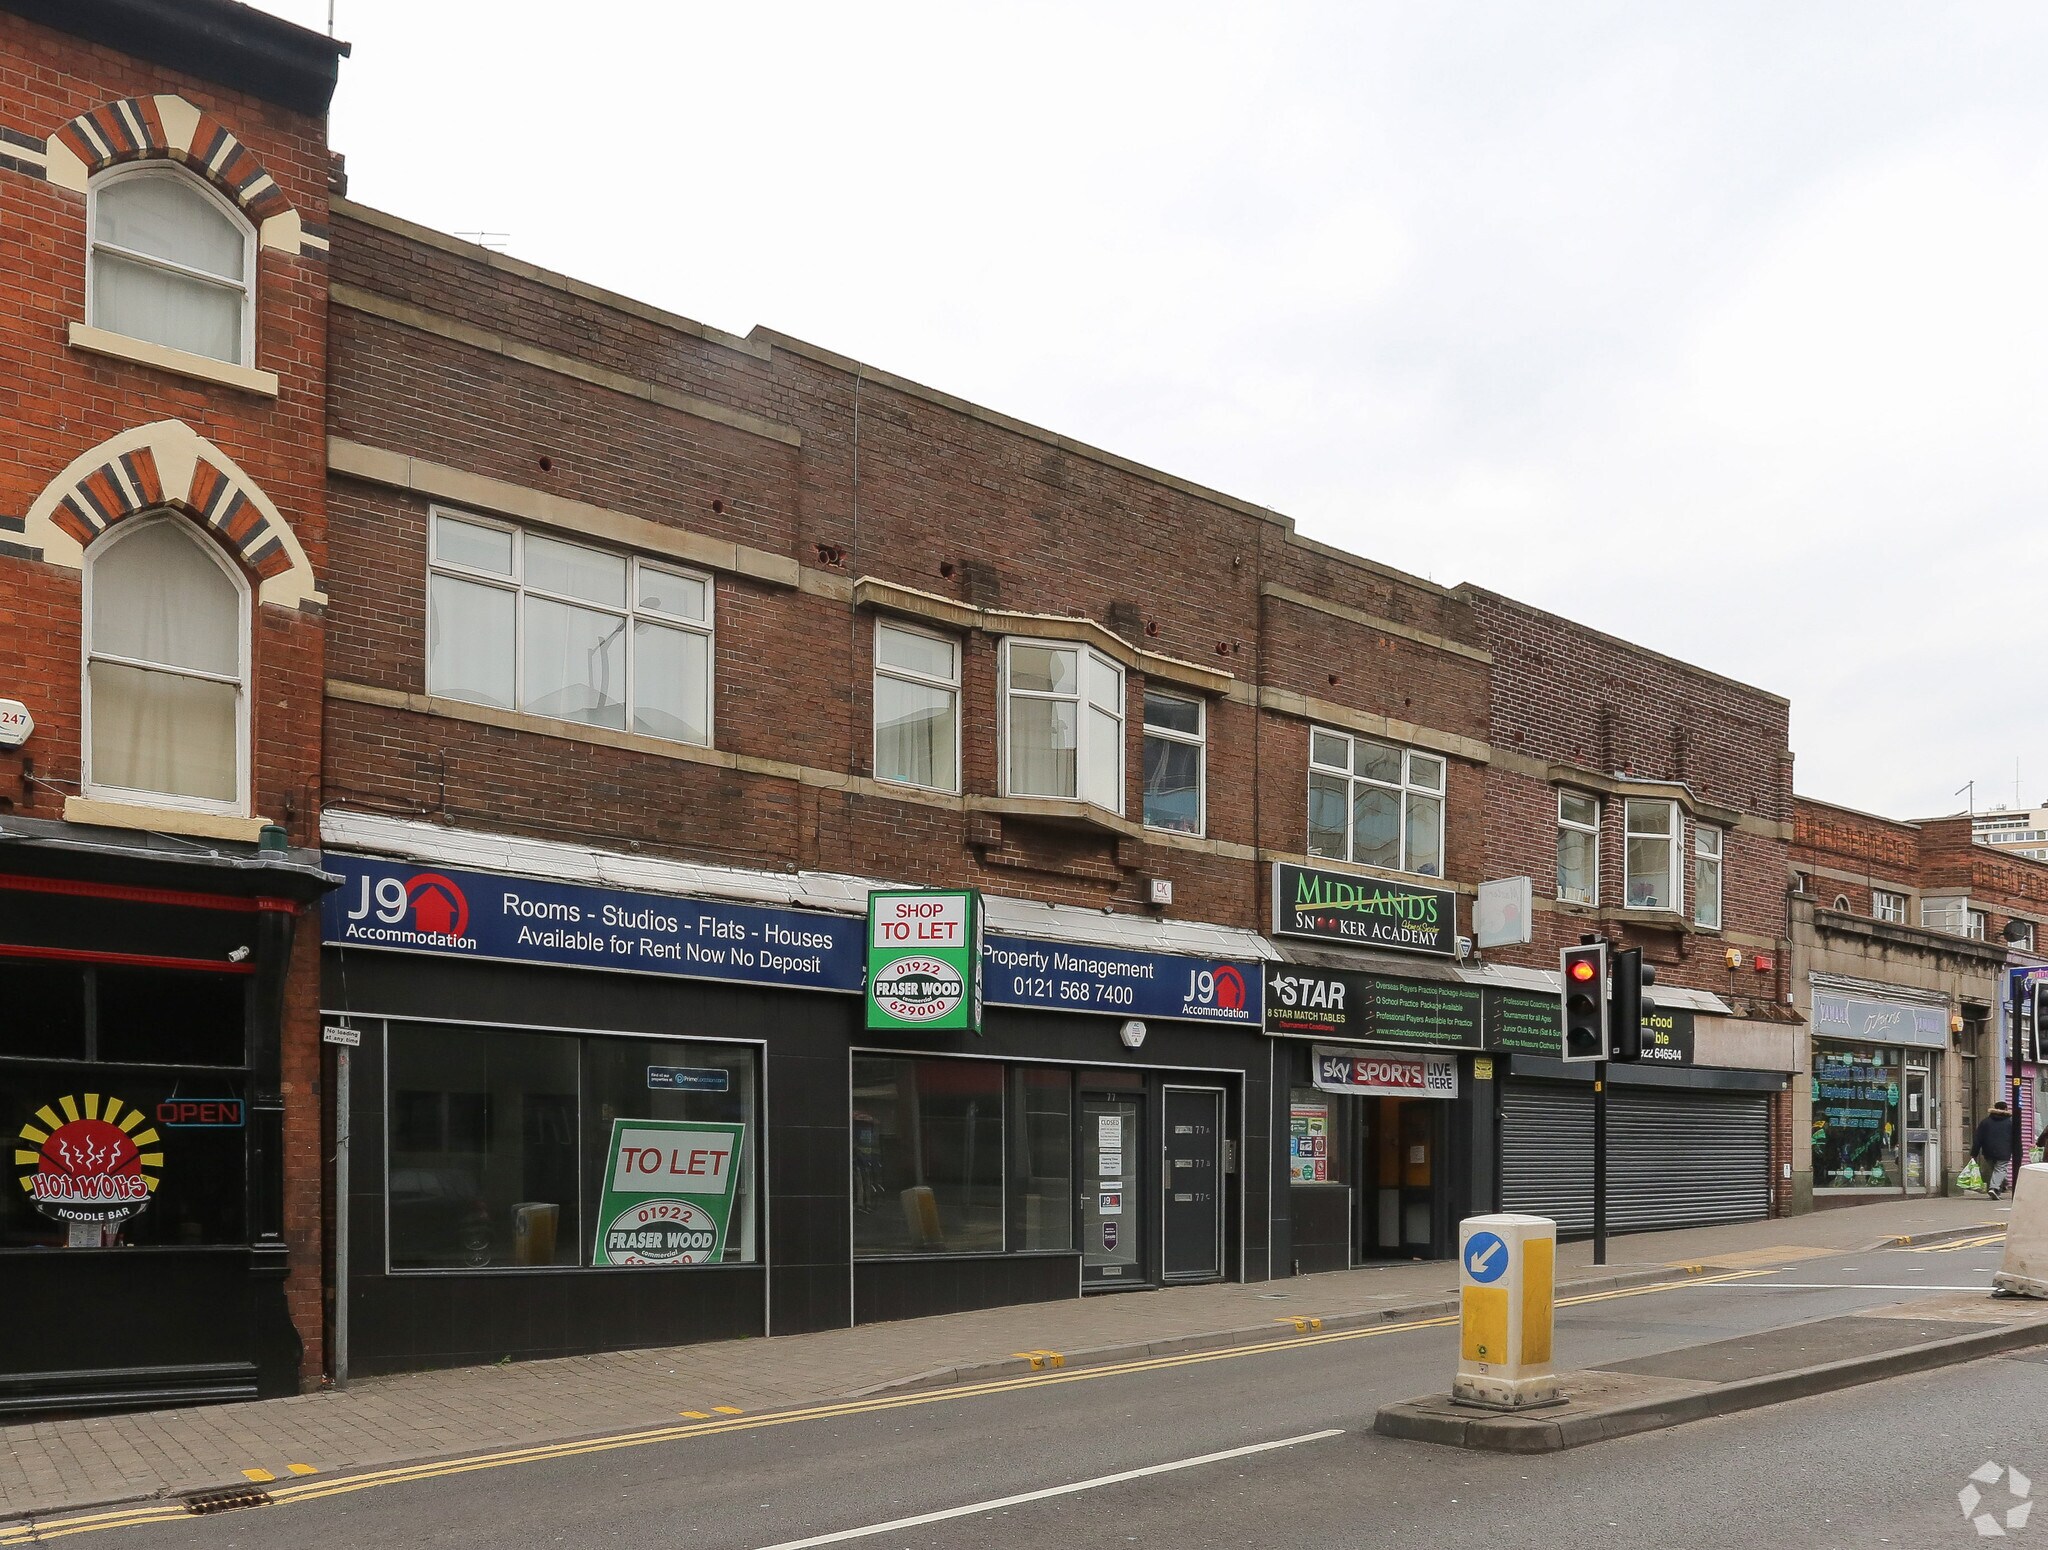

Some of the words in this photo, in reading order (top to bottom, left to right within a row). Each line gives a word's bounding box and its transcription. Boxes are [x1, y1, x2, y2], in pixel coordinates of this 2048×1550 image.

[2, 712, 26, 725] 247
[348, 875, 408, 924] J9
[1295, 872, 1438, 923] MIDLANDS
[896, 903, 944, 918] SHOP
[503, 893, 580, 922] Rooms
[602, 905, 678, 932] Studios
[699, 916, 745, 940] Flats
[766, 923, 833, 950] Houses
[346, 924, 477, 950] Accommodation
[881, 922, 910, 940] TO
[918, 922, 958, 940] LET
[1371, 922, 1438, 946] ACADEMY
[518, 925, 603, 953] Available
[610, 935, 634, 955] for
[640, 938, 681, 960] Rent
[687, 943, 725, 964] Now
[731, 948, 754, 966] No
[760, 951, 820, 974] Deposit
[896, 961, 941, 975] 01922
[1054, 952, 1154, 979] Management
[876, 982, 919, 996] FRASER
[922, 982, 960, 996] WOOD
[1014, 976, 1054, 998] 0121
[1060, 981, 1089, 1000] 568
[1096, 984, 1133, 1005] 7400
[1183, 969, 1215, 1003] J9
[1281, 976, 1346, 1010] STAR
[1399, 983, 1417, 993] Players
[890, 1000, 945, 1016] 629000
[902, 996, 933, 1004] commercial
[1382, 997, 1399, 1005] School
[1182, 1003, 1249, 1019] Accommodation
[1267, 1008, 1273, 1017] 8
[1273, 1009, 1293, 1018] STAR
[1294, 1010, 1318, 1021] MATCH
[1319, 1012, 1346, 1023] TABLES
[1654, 1048, 1682, 1060] 646544
[1323, 1058, 1350, 1083] sky
[1357, 1062, 1423, 1084] SPORTS
[1427, 1062, 1451, 1077] LIVE
[1427, 1077, 1453, 1090] HERE
[156, 1103, 238, 1123] OPEN
[621, 1148, 663, 1174] TO
[670, 1149, 728, 1176] LET
[57, 1208, 105, 1221] NOODLE
[107, 1207, 130, 1220] BAR
[638, 1206, 693, 1223] 01922
[608, 1232, 663, 1249] FRASER
[667, 1232, 713, 1248] WOOD
[641, 1248, 678, 1259] commercial
